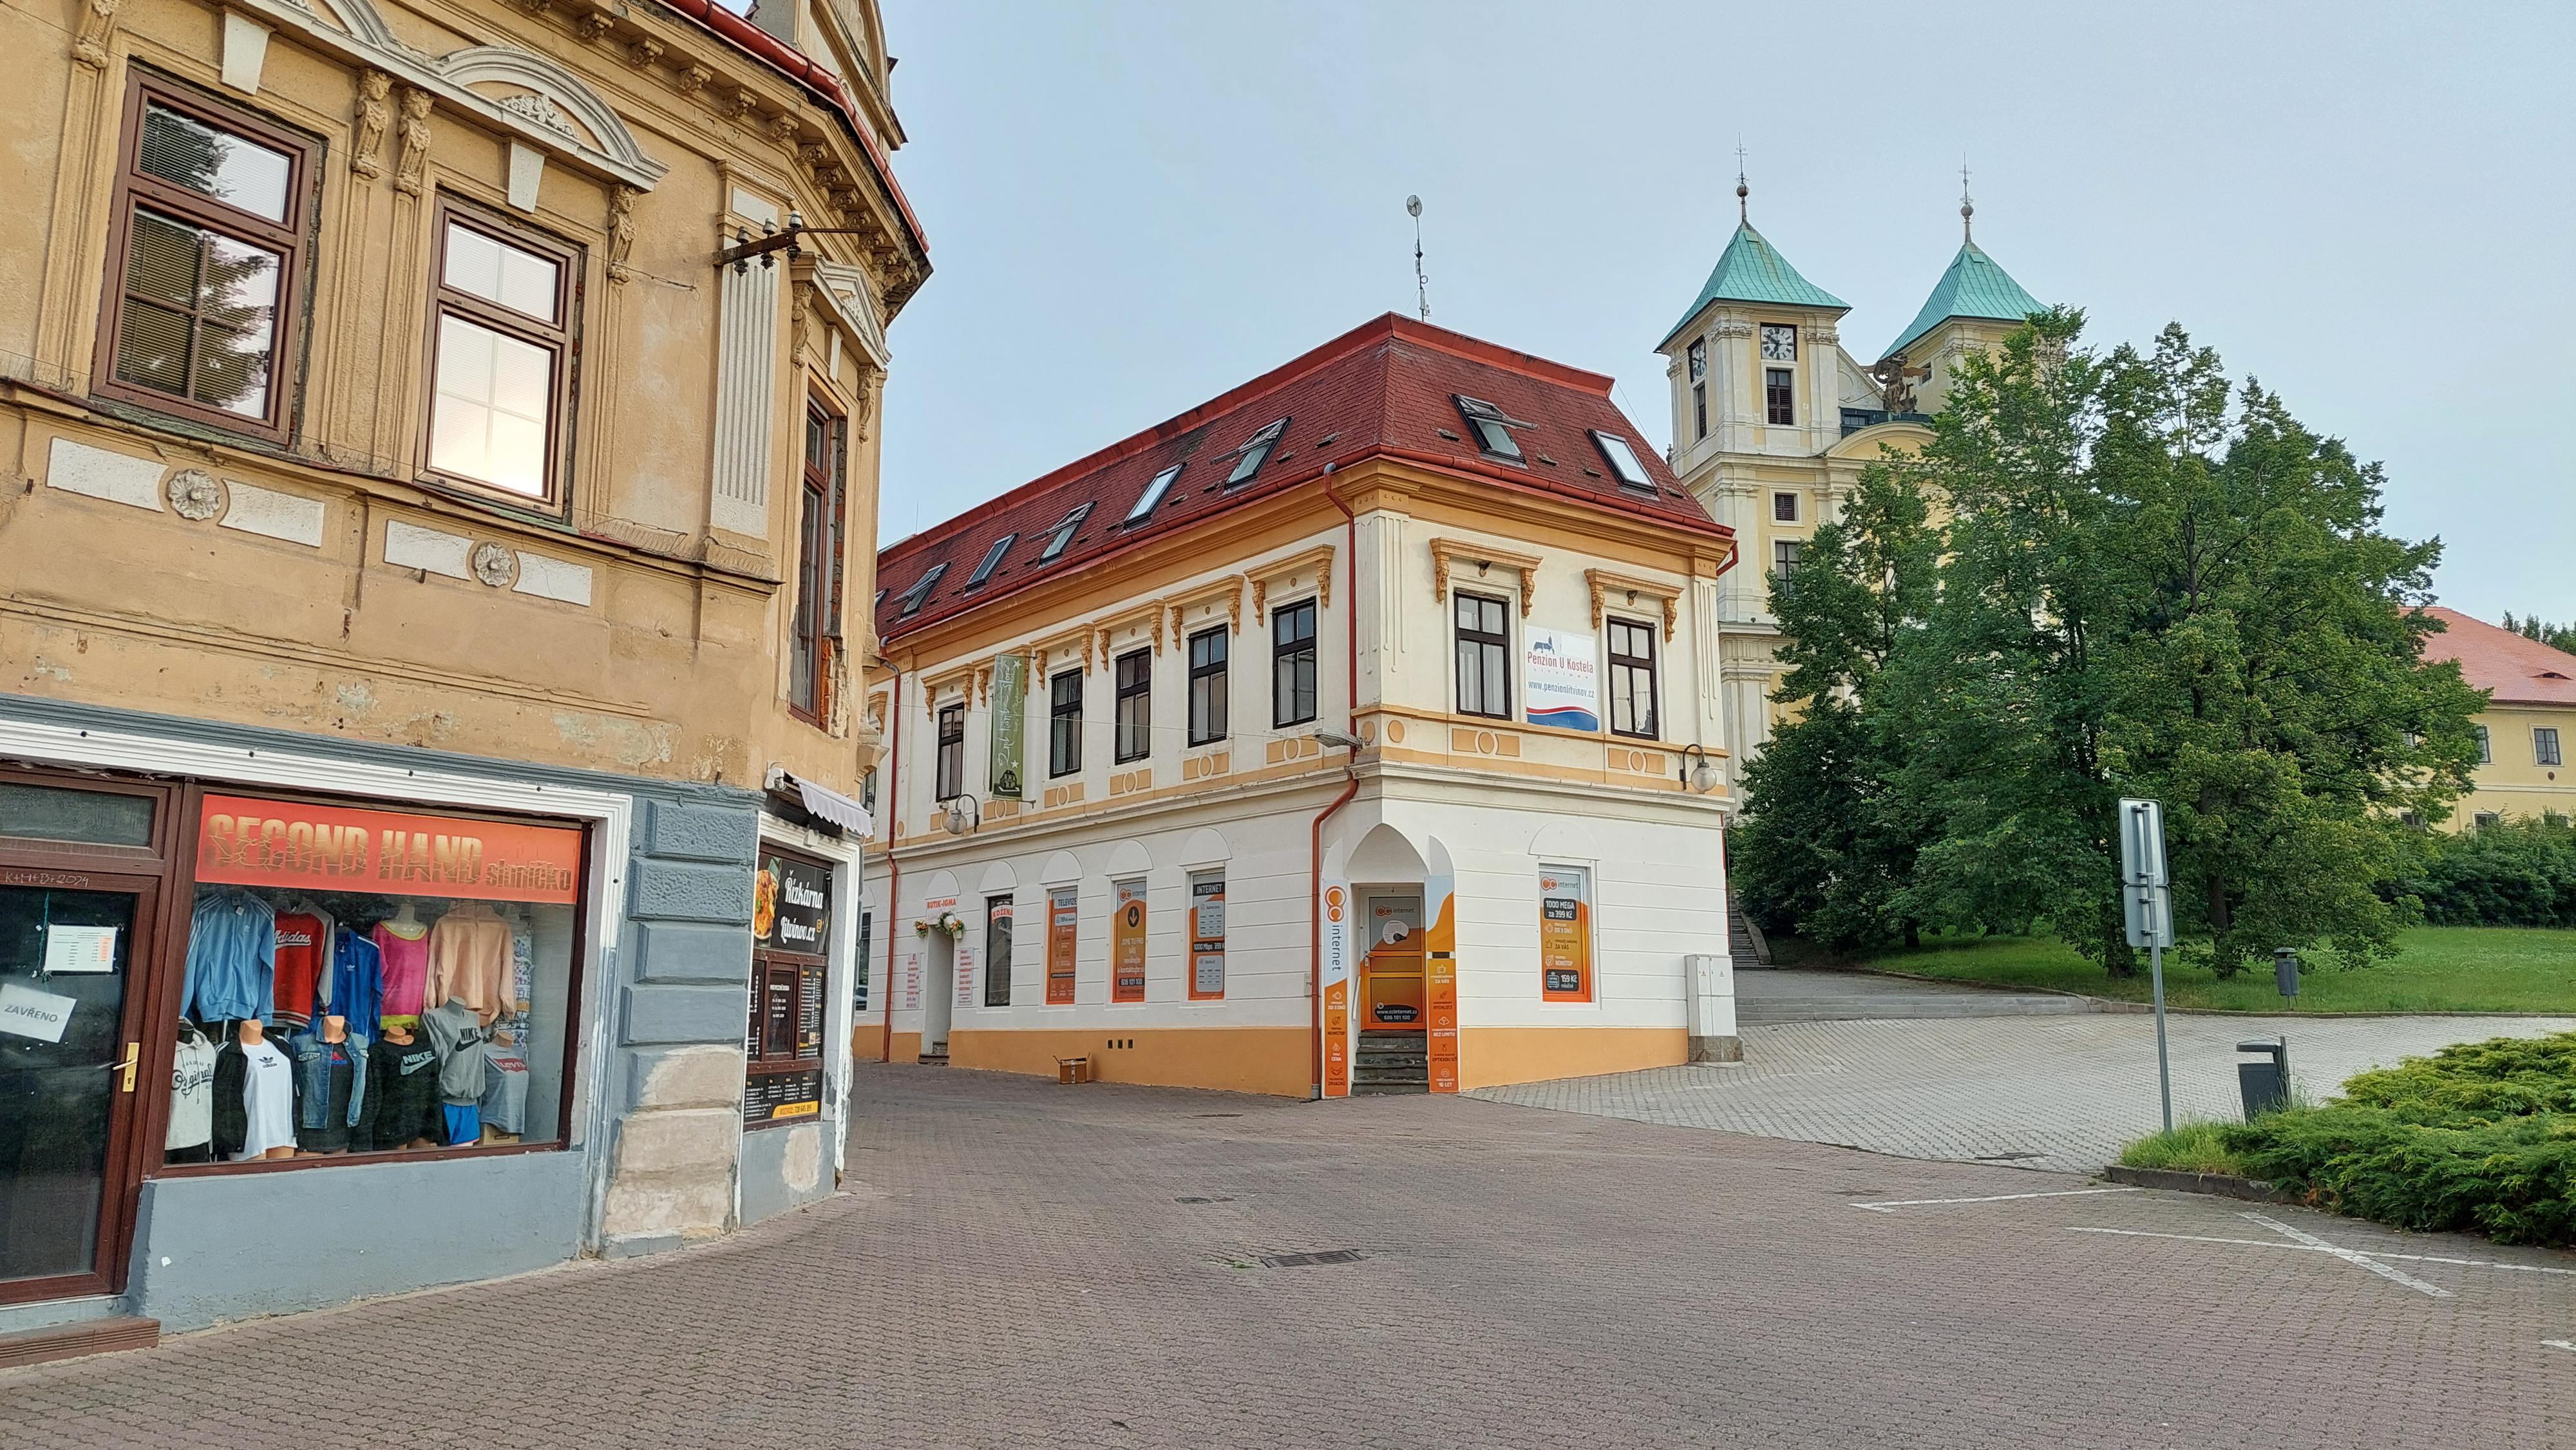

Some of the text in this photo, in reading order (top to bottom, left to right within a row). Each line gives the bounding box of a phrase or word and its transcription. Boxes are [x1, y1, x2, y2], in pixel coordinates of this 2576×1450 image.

[1528, 651, 1593, 673] Penzion U Kostela
[1528, 681, 1595, 699] www.penzionlitvinov.cz
[207, 814, 370, 877] SECOND
[379, 829, 482, 885] HAND
[785, 869, 824, 910] Řízkárna
[1197, 883, 1222, 894] INTERNET
[1558, 880, 1579, 889] internet
[1546, 900, 1575, 910] 1000 MEGA
[1555, 910, 1566, 919] 399
[1566, 910, 1573, 919] Kč
[780, 916, 816, 945] Litvínov.cz
[1332, 925, 1343, 972] internet
[1561, 974, 1570, 983] 159
[1571, 974, 1578, 983] Kč
[5, 1004, 59, 1023] ZAVŘENO
[459, 1027, 480, 1041] NIKE
[402, 1050, 433, 1064] NIKE
